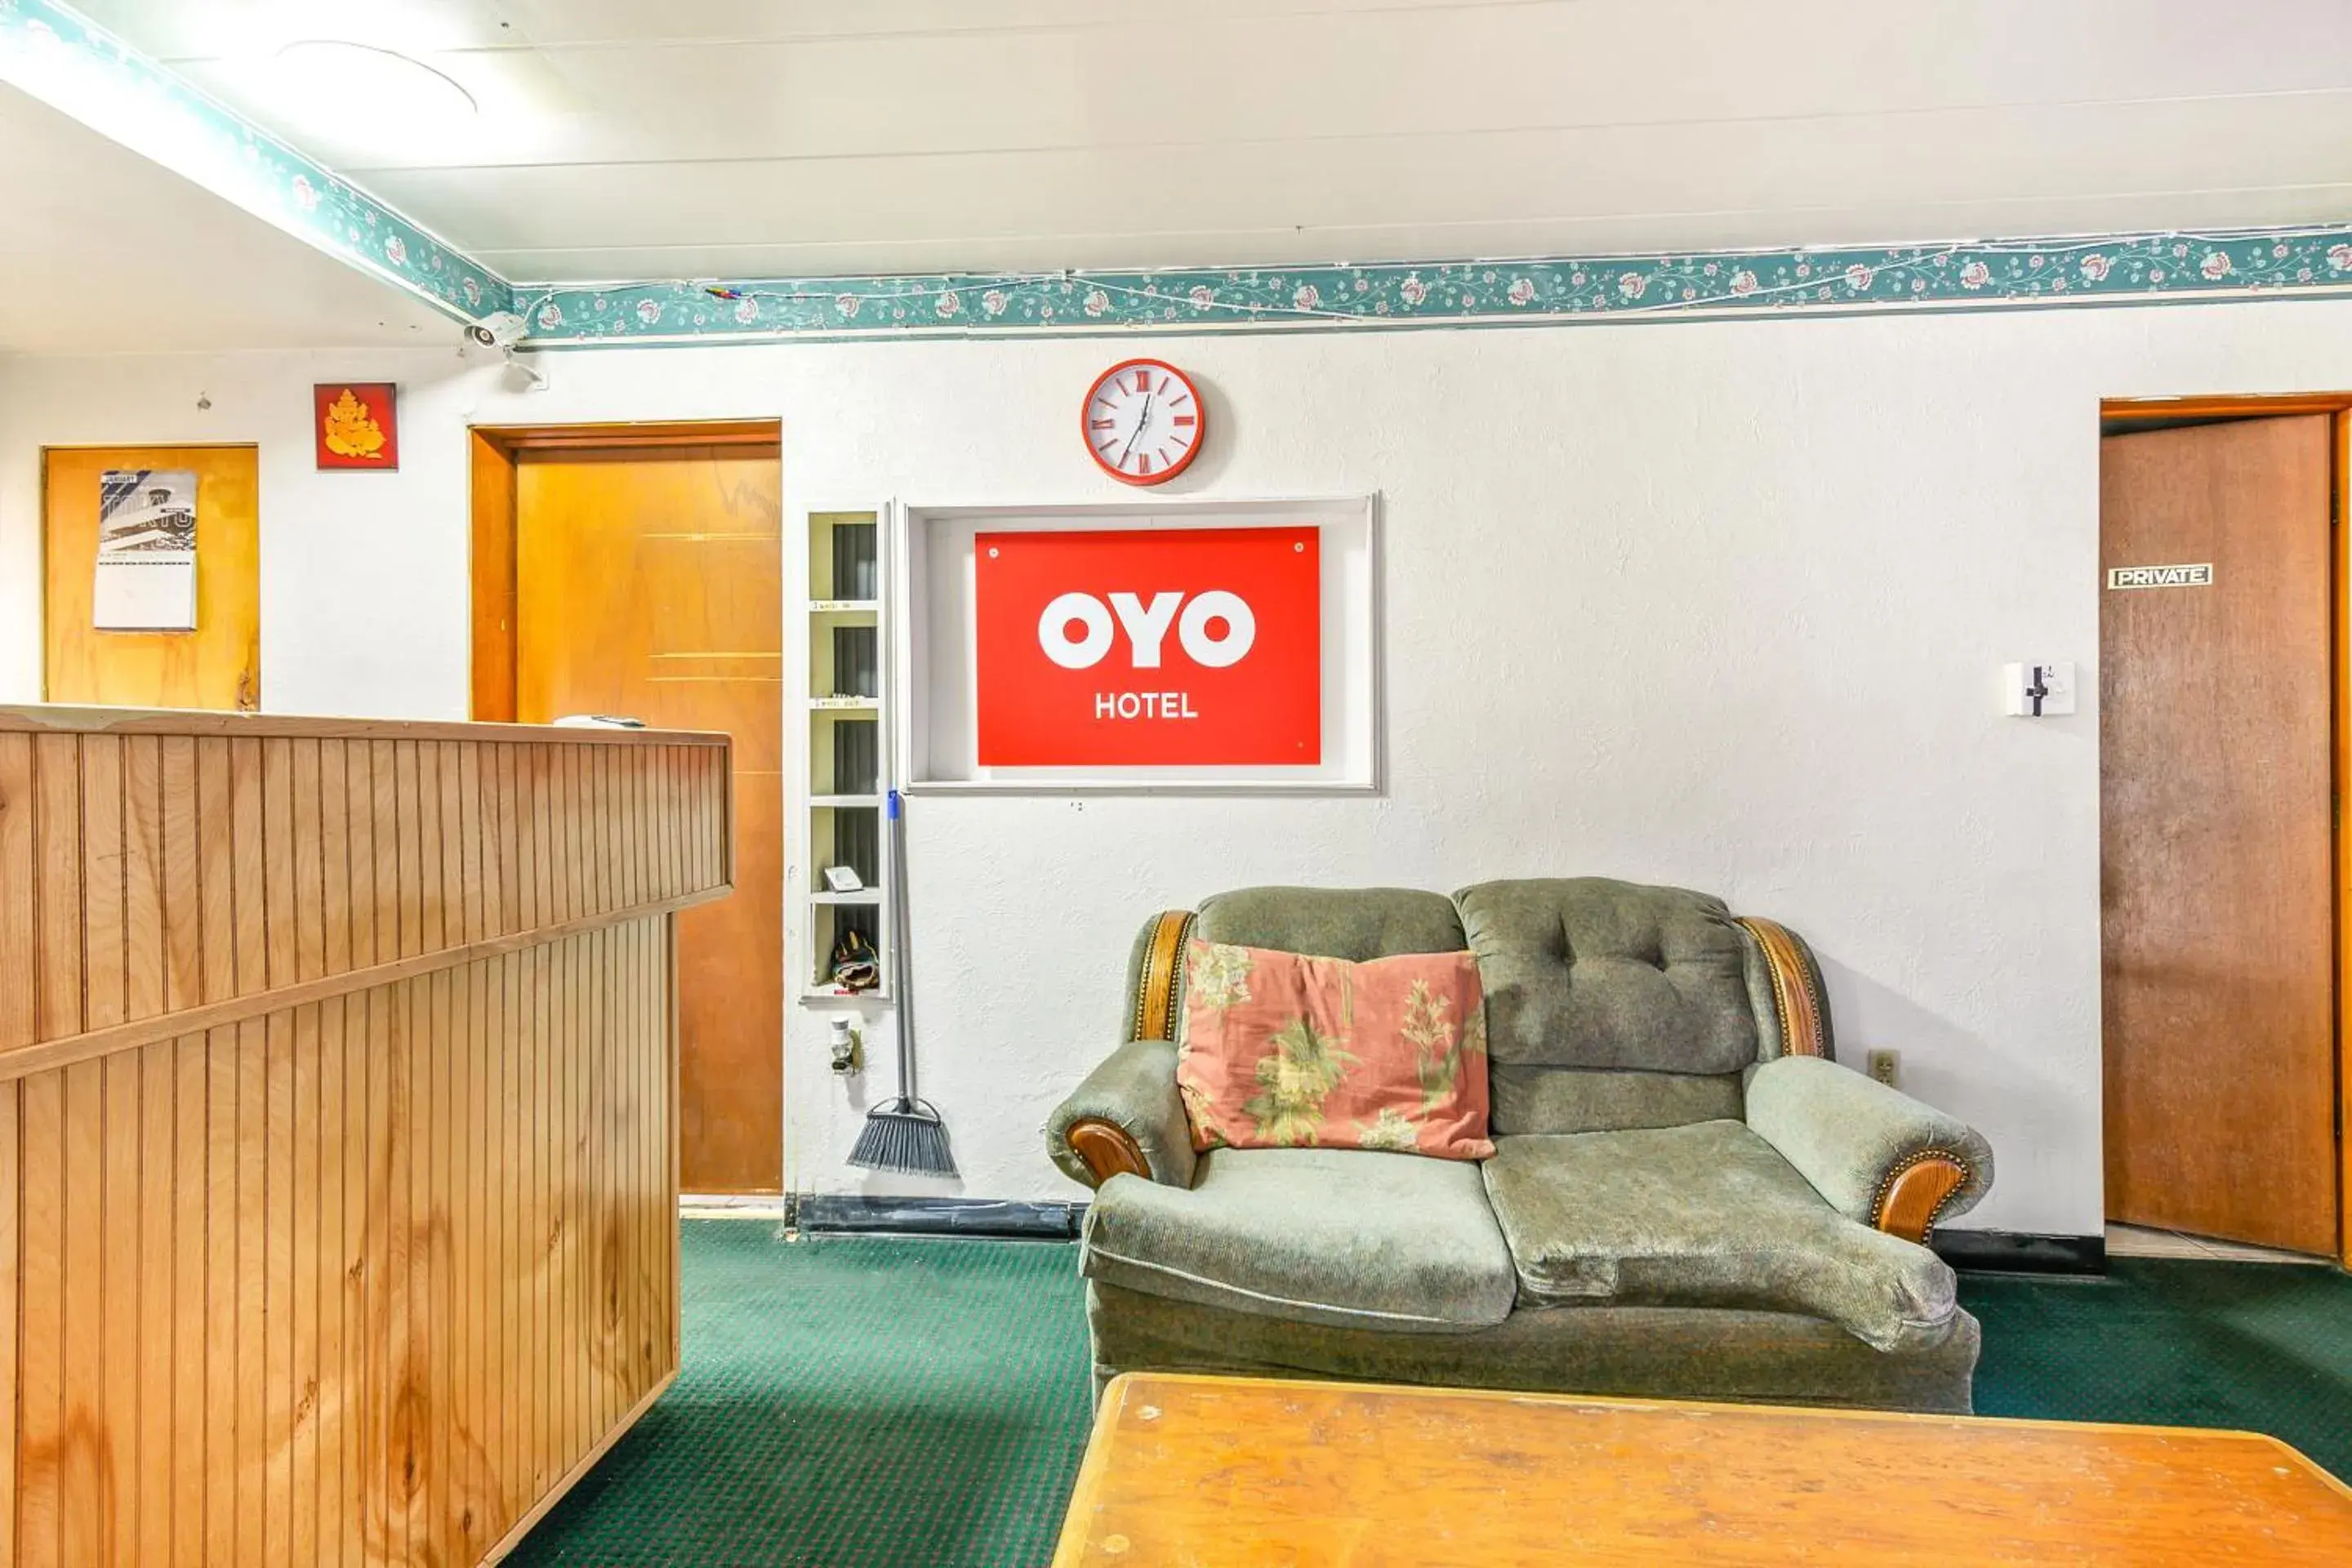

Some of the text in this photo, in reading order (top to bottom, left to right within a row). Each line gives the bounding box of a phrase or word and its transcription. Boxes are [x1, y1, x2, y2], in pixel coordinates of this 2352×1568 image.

[2118, 568, 2206, 586] PRIVATE
[1038, 590, 1256, 669] OYO
[1094, 692, 1199, 719] HOTEL
